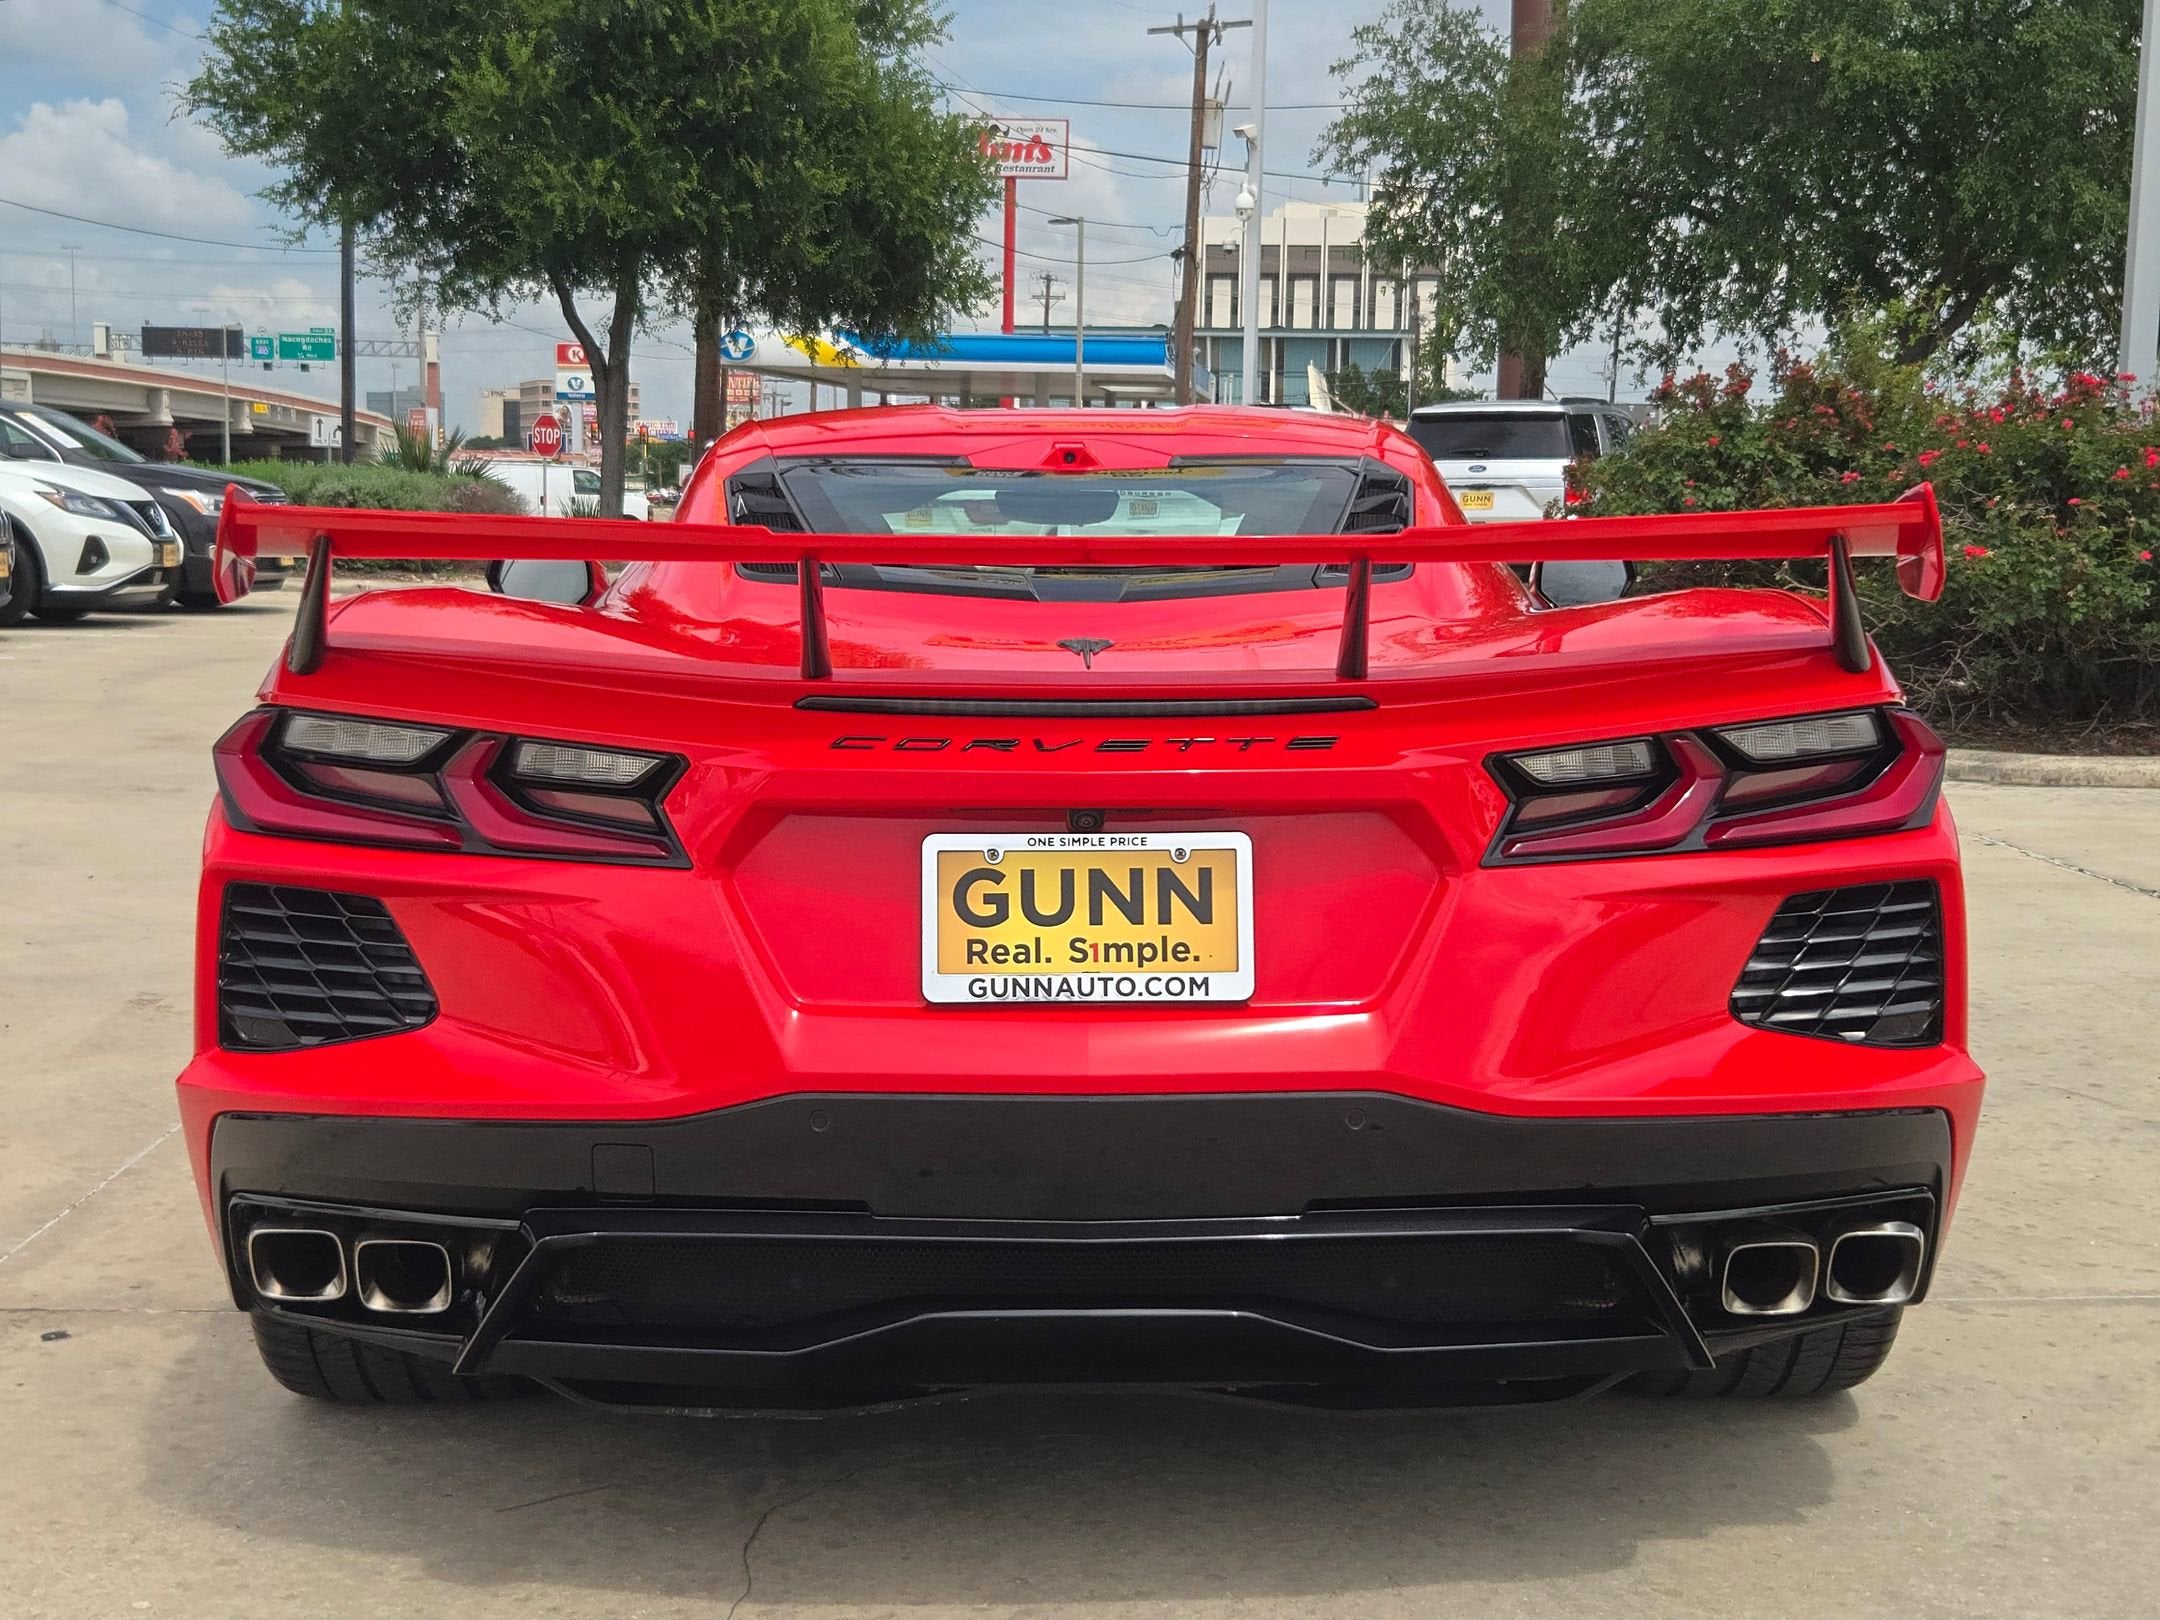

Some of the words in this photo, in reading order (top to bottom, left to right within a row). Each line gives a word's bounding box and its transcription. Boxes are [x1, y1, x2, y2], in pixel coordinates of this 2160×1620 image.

[281, 336, 332, 344] Nacogdoches
[534, 427, 560, 444] STOP
[1462, 495, 1491, 503] GUNN
[829, 735, 1341, 753] CORVETTE
[1027, 837, 1055, 847] ONE
[1059, 837, 1106, 847] SIMPLE
[1110, 836, 1148, 846] PRICE
[952, 866, 1214, 929] GUNN
[966, 937, 1052, 965] Real.
[967, 976, 1210, 999] GUNNAUTO.COM
